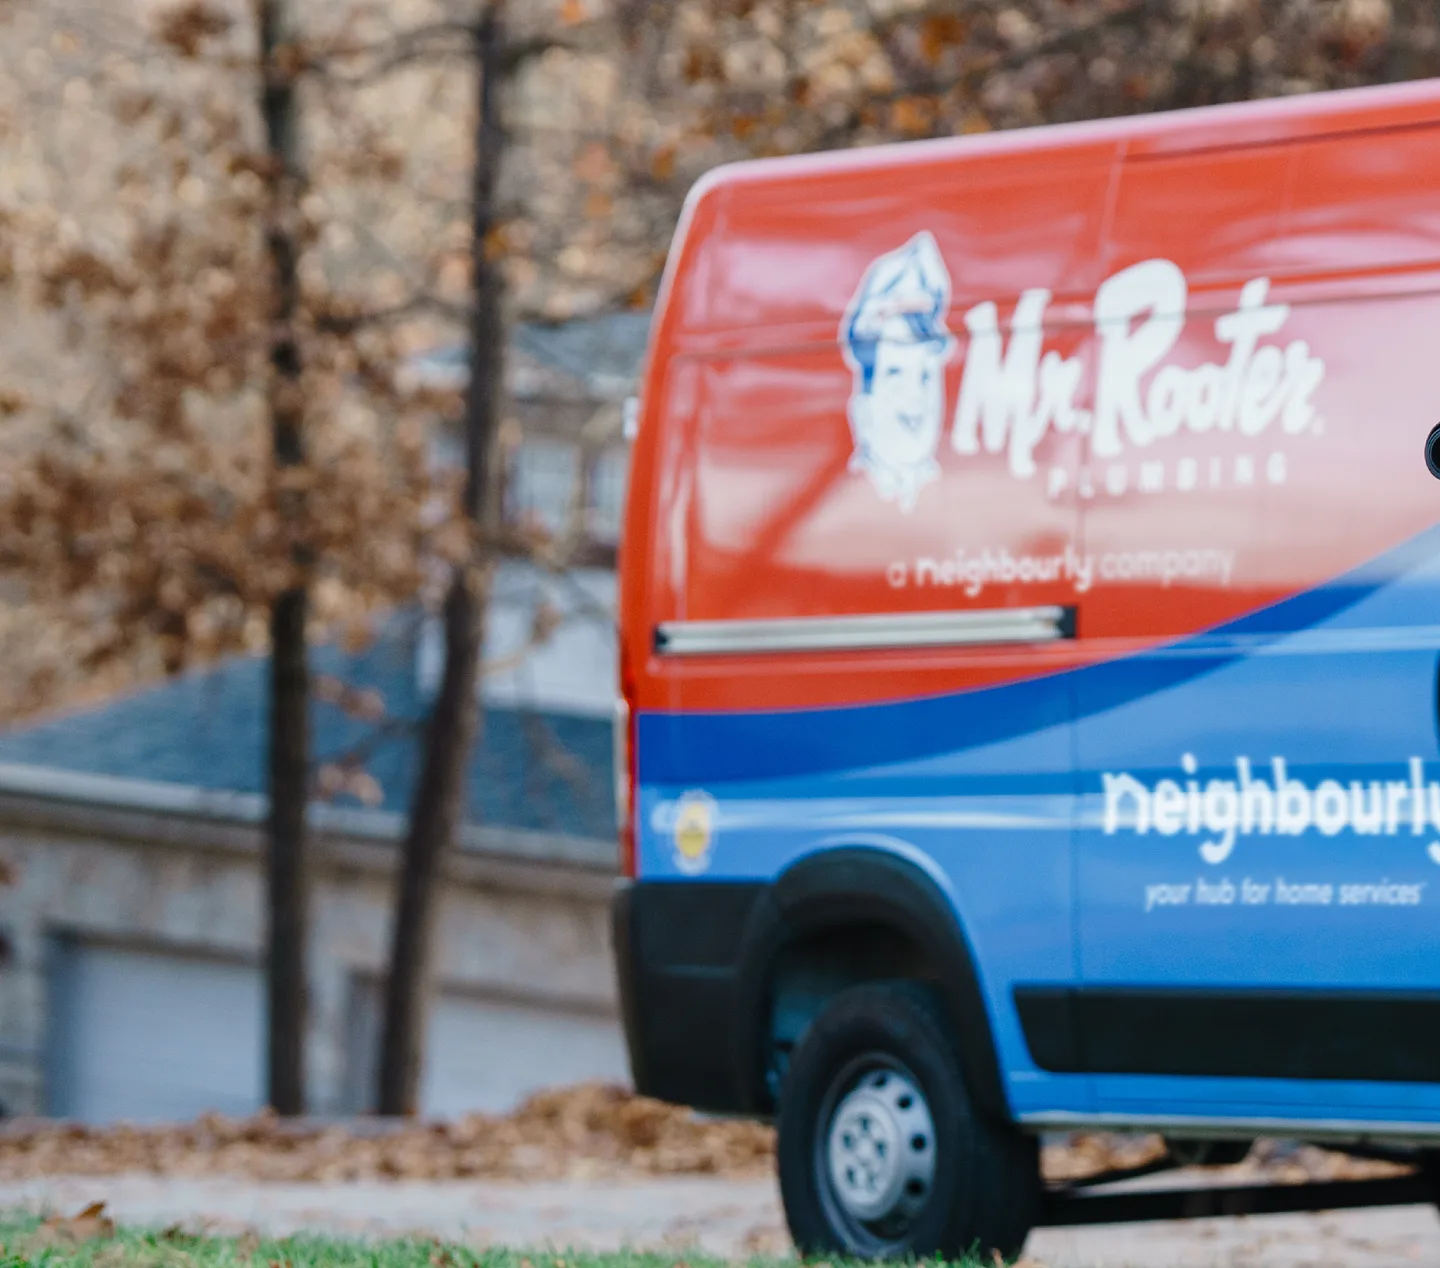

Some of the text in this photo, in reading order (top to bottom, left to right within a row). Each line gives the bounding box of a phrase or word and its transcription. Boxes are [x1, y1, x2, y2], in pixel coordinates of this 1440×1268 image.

[952, 258, 1325, 479] Mr. Rooter
[1046, 451, 1289, 498] PLUMBING
[886, 545, 1235, 598] a neighbourly company
[1145, 876, 1421, 914] your hub for home services
